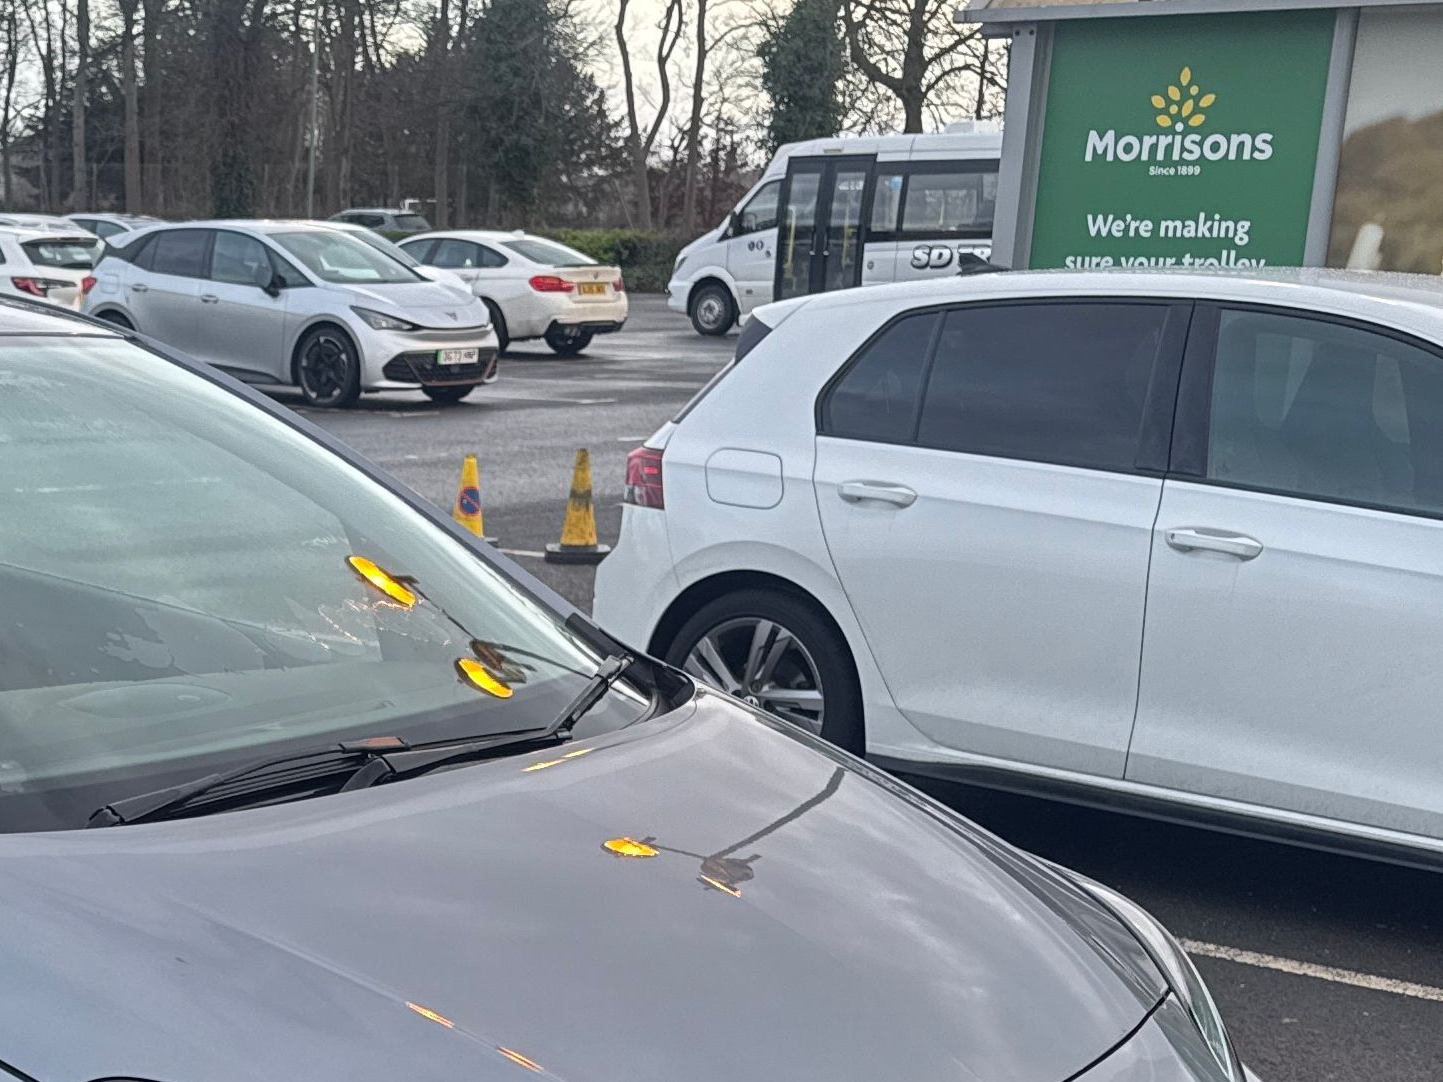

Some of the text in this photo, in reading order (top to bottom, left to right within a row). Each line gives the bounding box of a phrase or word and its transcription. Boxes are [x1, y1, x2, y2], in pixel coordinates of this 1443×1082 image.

[1084, 121, 1274, 162] Morrisons
[1148, 165, 1201, 176] Since 1899
[1086, 212, 1251, 246] We're making
[911, 245, 953, 269] SD
